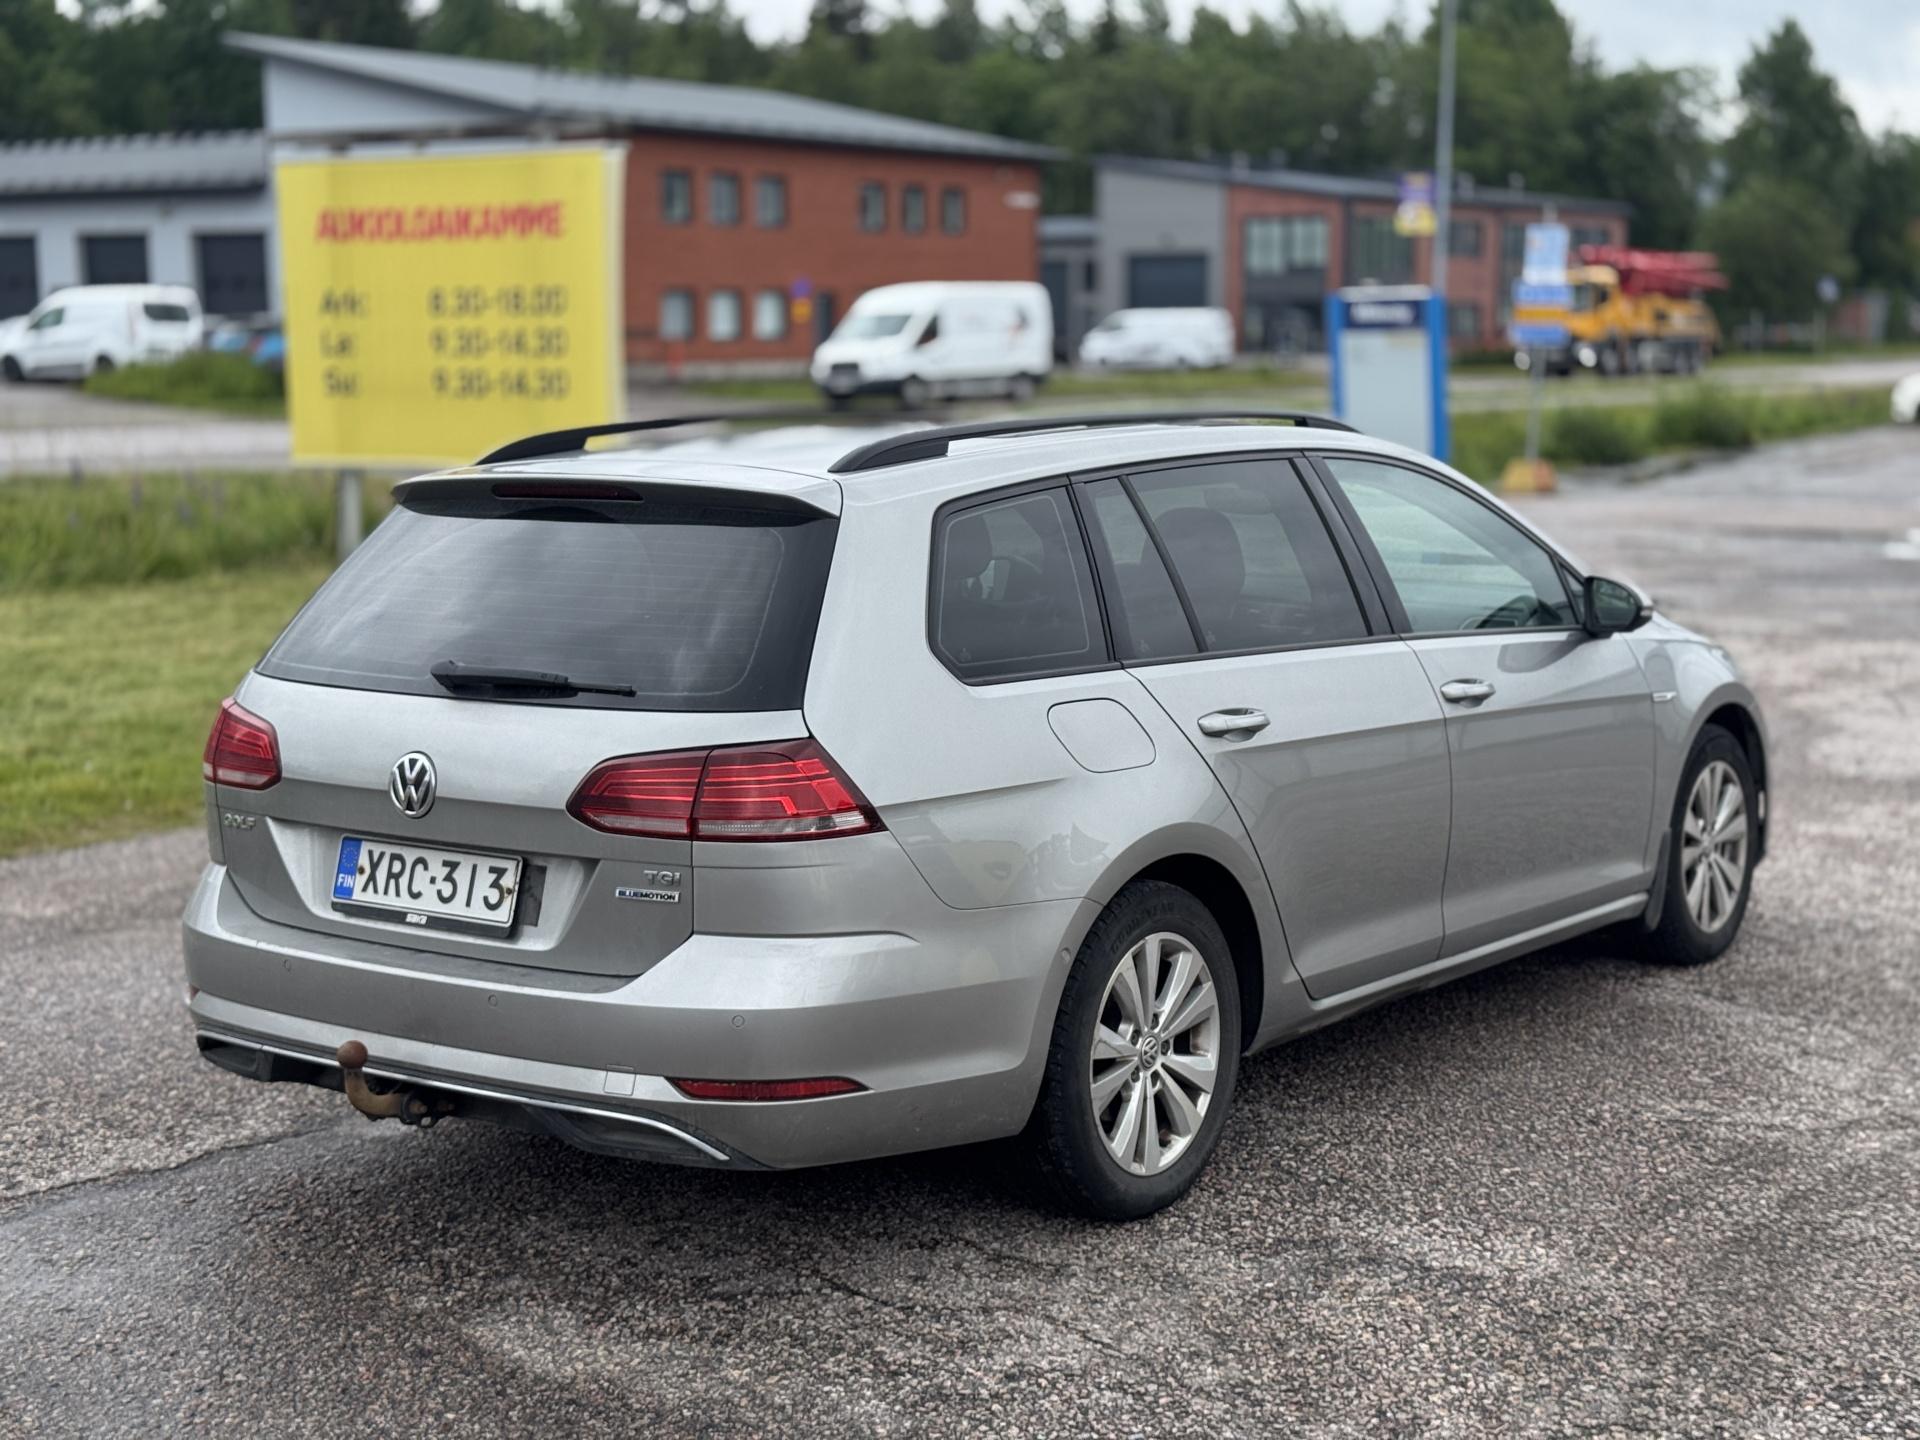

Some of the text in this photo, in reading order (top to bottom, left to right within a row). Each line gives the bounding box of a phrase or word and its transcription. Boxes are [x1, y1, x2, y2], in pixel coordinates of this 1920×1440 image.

[223, 812, 257, 829] GOLF
[337, 873, 356, 888] FIN
[361, 849, 509, 911] XRC-313
[643, 869, 681, 887] TGI
[617, 889, 677, 901] BLUEMOTION
